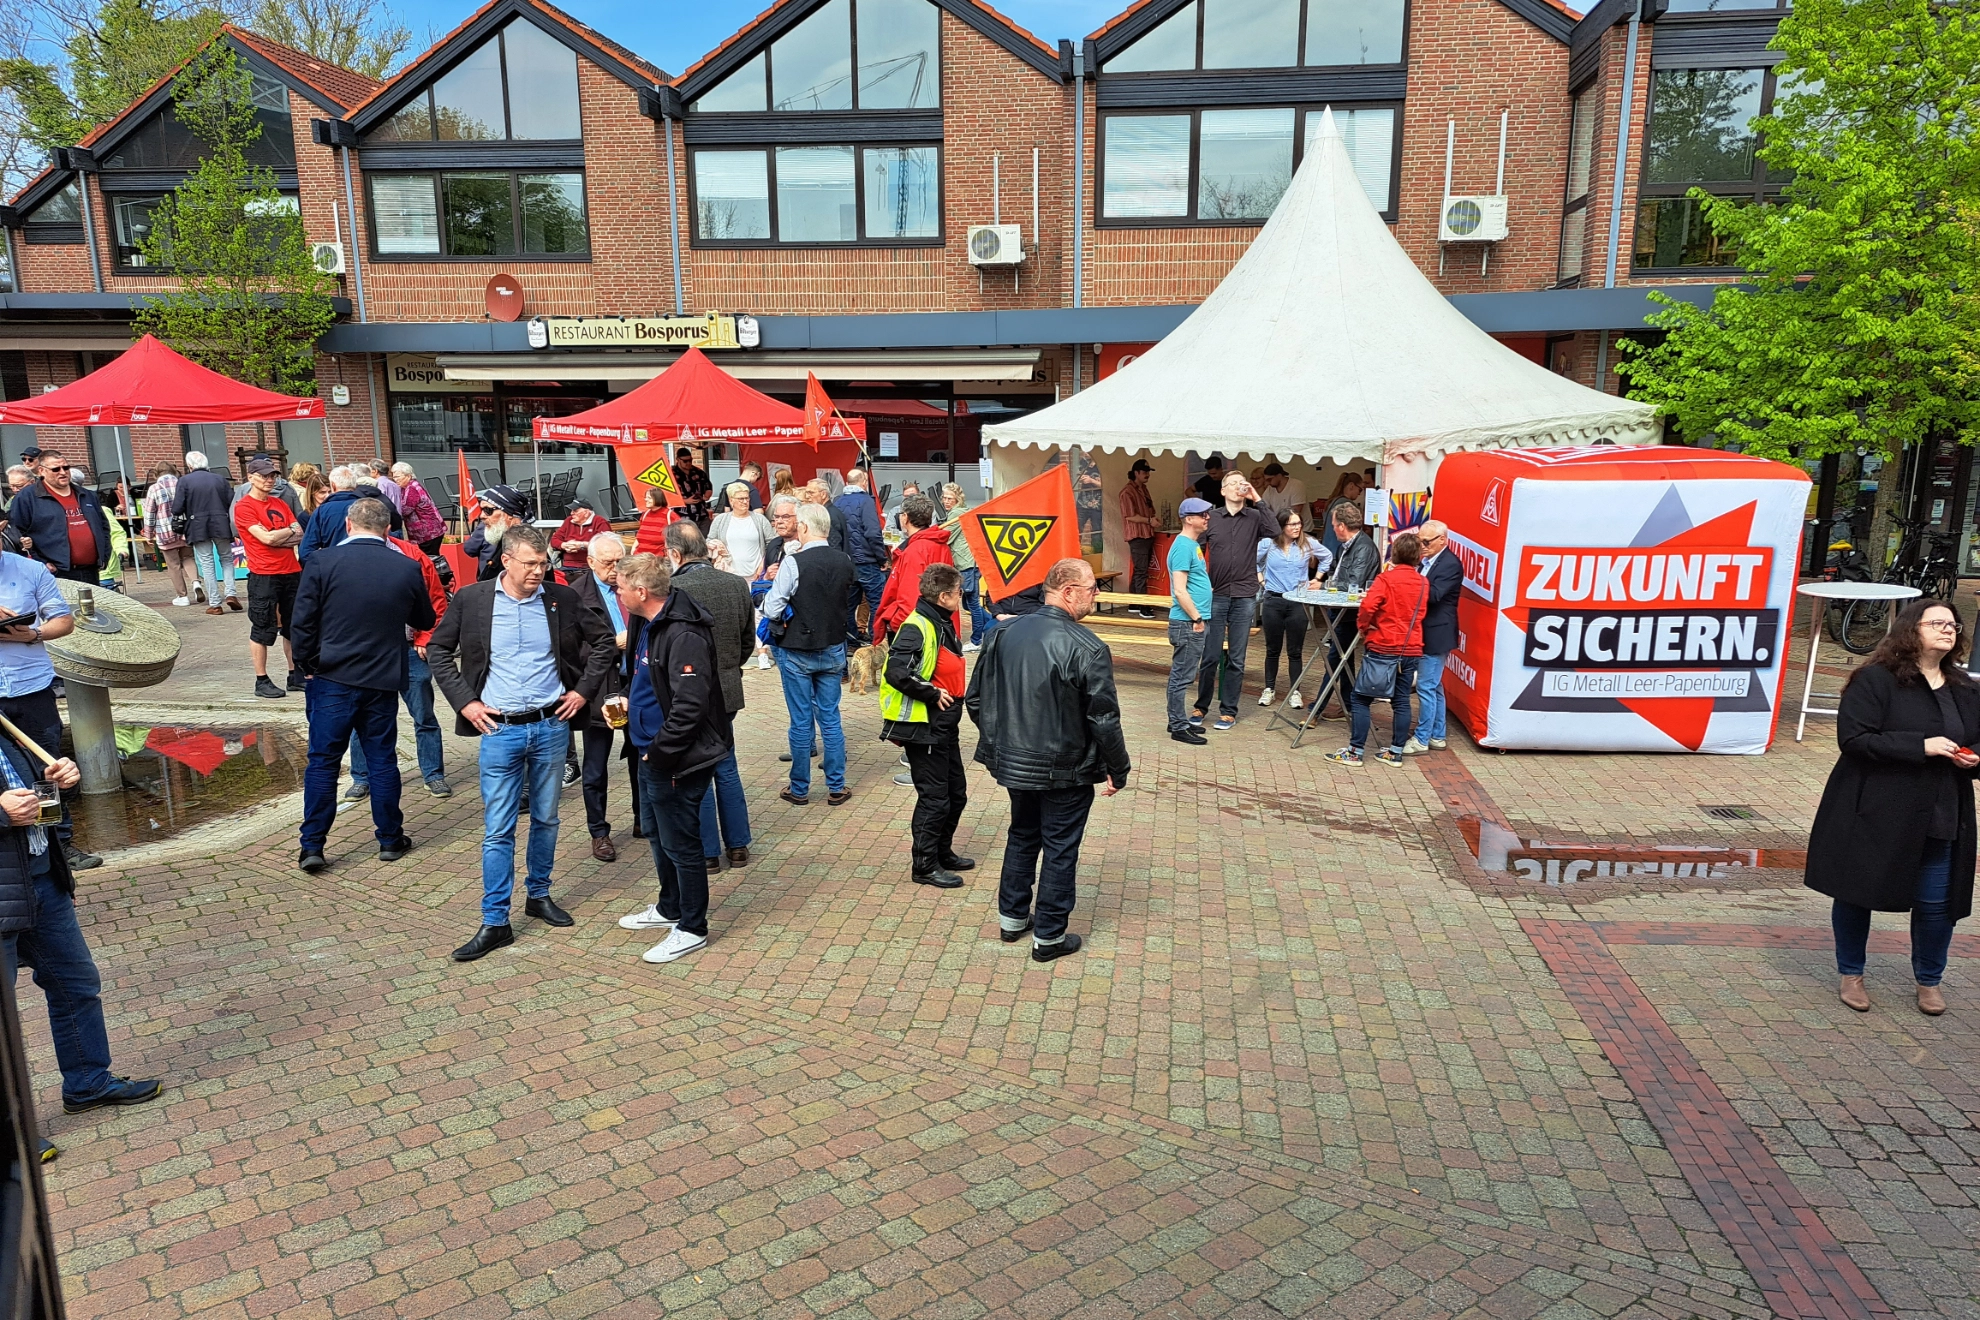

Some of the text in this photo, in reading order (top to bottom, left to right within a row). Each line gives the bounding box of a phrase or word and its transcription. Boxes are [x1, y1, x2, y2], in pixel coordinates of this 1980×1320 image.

[554, 322, 709, 342] RESTAURANT Bosporus
[407, 361, 437, 369] RESTAUR
[557, 424, 574, 435] Metall
[574, 426, 586, 436] Leer
[590, 426, 621, 440] Papenburg
[698, 427, 710, 437] IG
[712, 427, 744, 437] Metall
[746, 427, 767, 436] Leer
[775, 426, 827, 438] Papeng
[1525, 554, 1764, 601] ZUKUNFT
[1530, 615, 1769, 662] SICHERN.
[1552, 674, 1747, 695] IG Metall Leer-Papenburg
